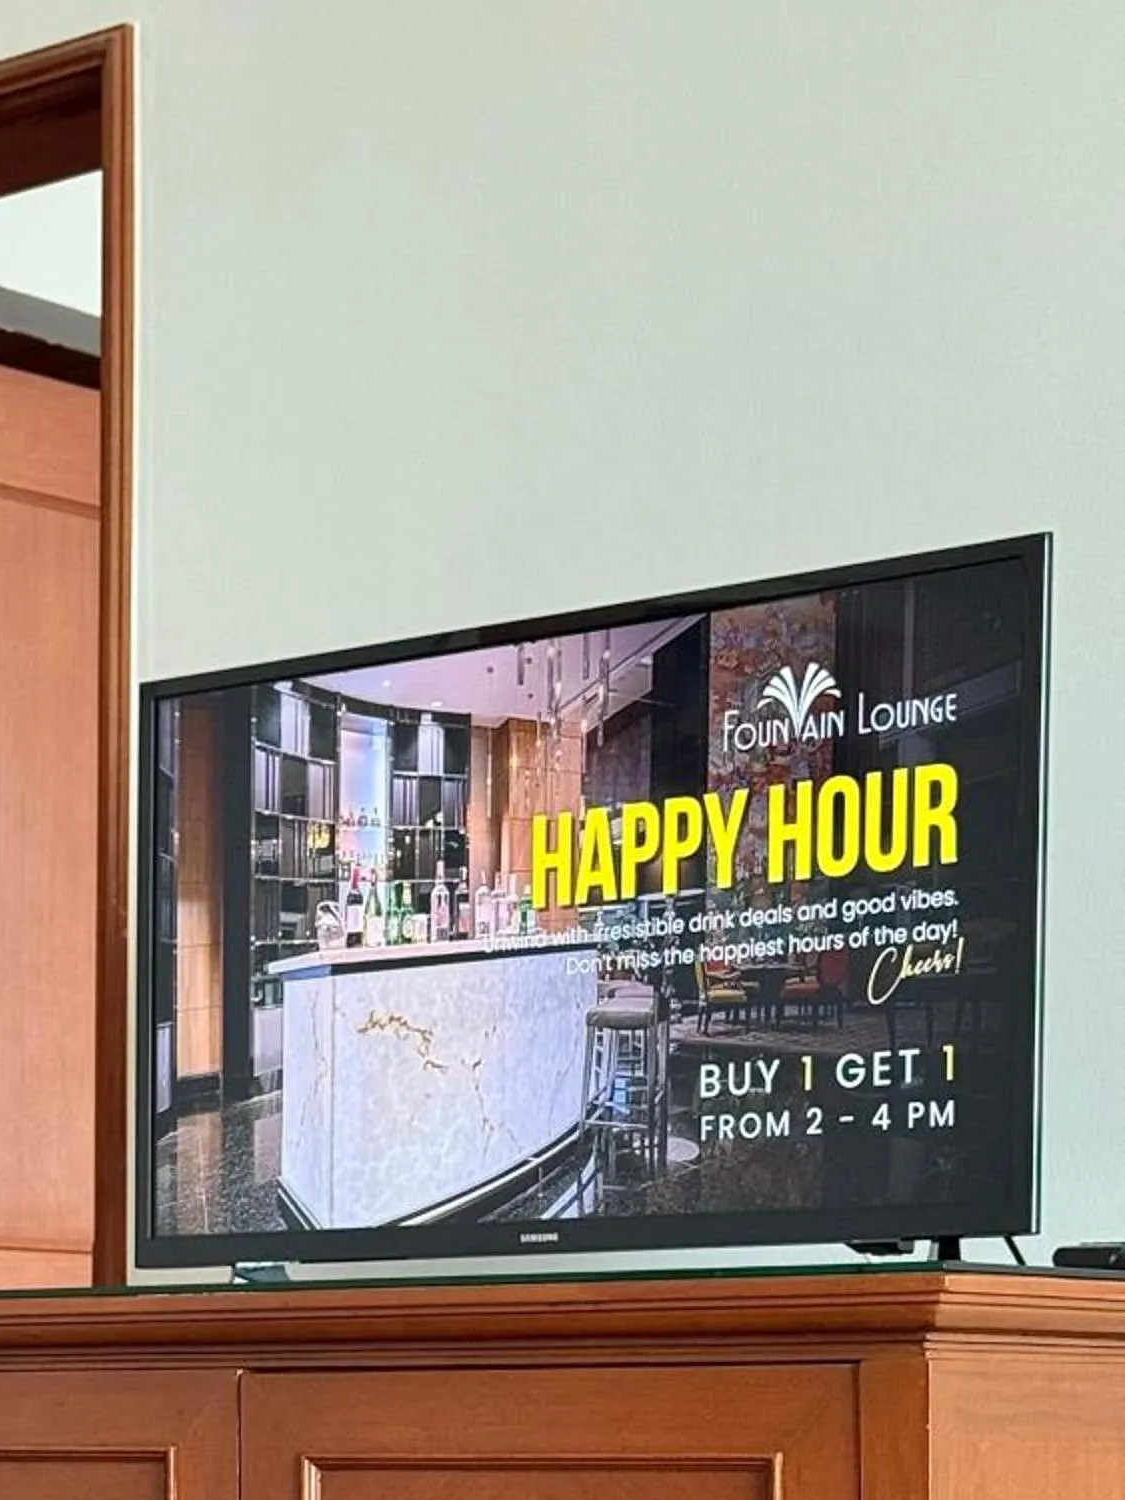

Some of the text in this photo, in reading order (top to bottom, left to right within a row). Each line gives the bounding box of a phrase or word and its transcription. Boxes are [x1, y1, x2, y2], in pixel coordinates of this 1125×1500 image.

[532, 763, 959, 910] HAPPY HOUR
[549, 924, 589, 945] with
[595, 915, 684, 942] irresistible
[688, 907, 736, 931] drink
[739, 903, 793, 927] deals
[797, 898, 838, 922] and
[841, 892, 896, 923] good
[900, 888, 960, 912] vibes.
[566, 918, 959, 975] Don't miss the happiest hours of the day!
[867, 936, 966, 1005] Cheers!
[699, 1044, 955, 1099] BUY 1 GET 1
[700, 1110, 791, 1141] FROM
[805, 1106, 823, 1136] 2
[871, 1103, 892, 1131] 4
[907, 1099, 956, 1129] PM
[520, 1232, 559, 1244] SAMSUNG
